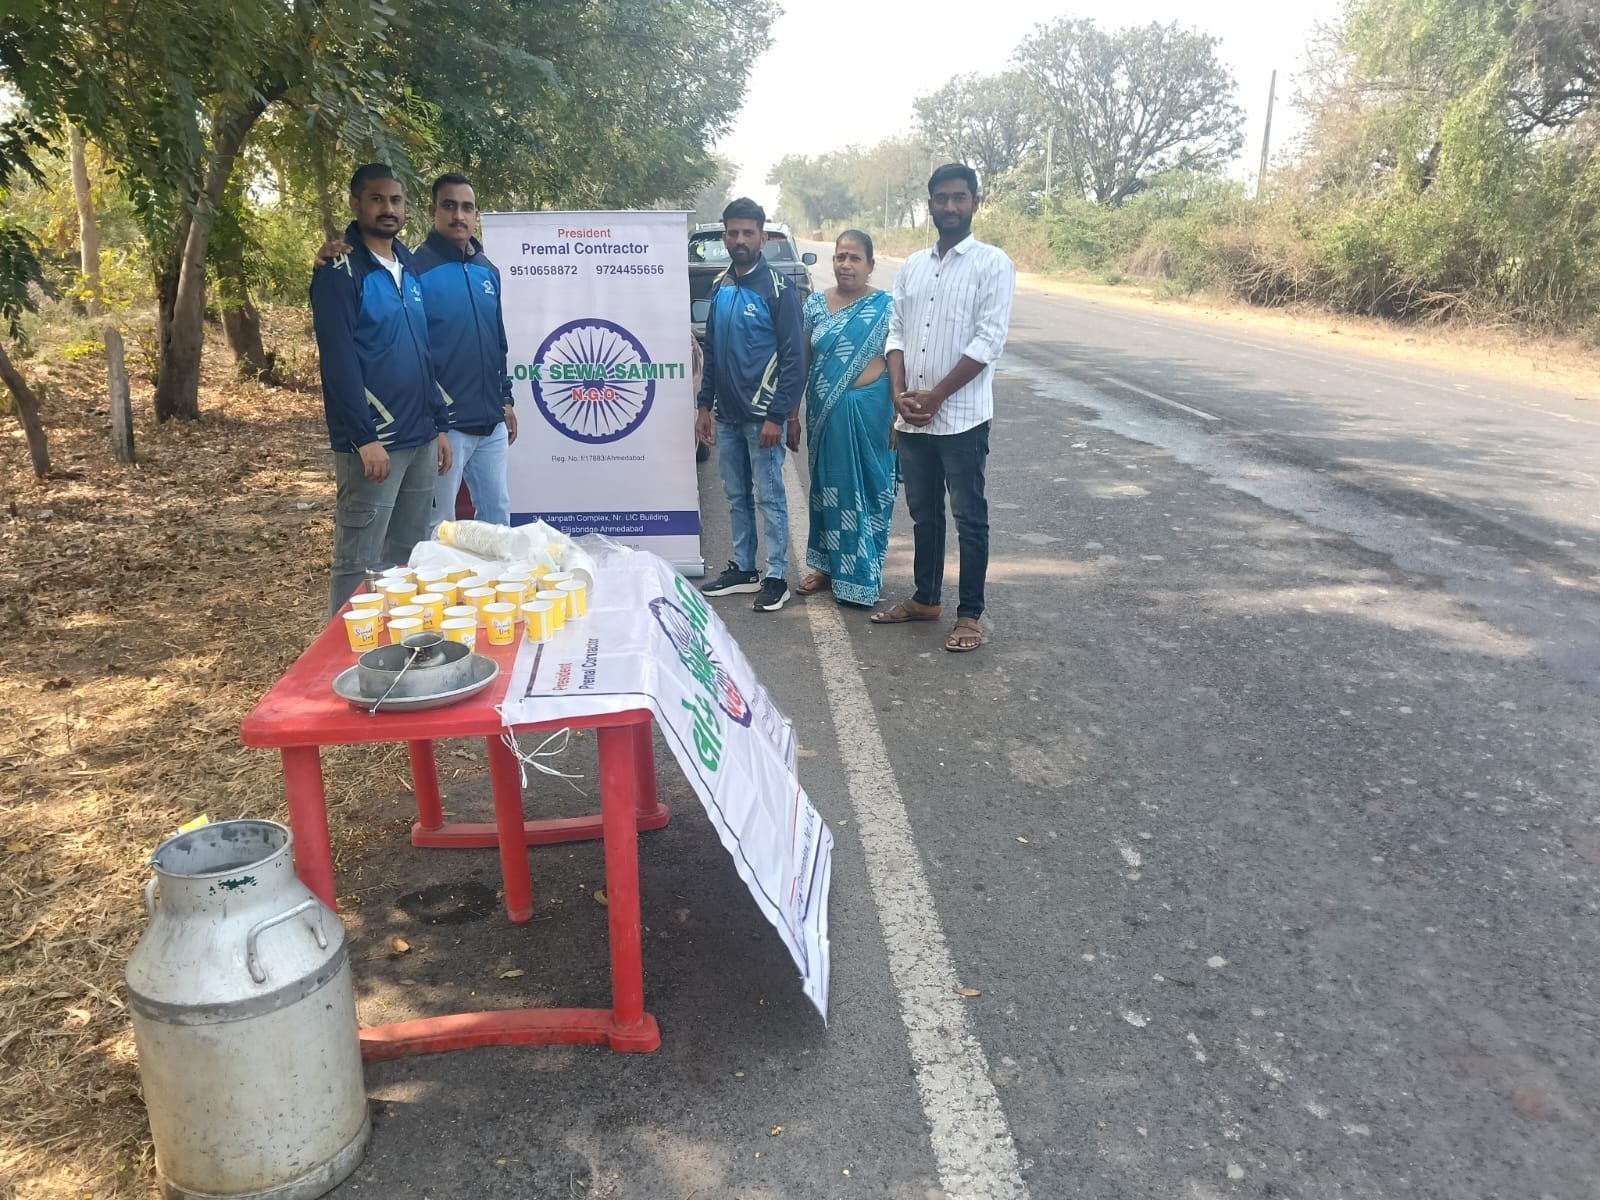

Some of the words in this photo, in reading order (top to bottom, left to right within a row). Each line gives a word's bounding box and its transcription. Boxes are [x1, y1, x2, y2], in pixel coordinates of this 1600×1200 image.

[558, 228, 611, 238] President
[522, 243, 569, 255] Premal
[574, 242, 649, 254] Contractor
[510, 265, 578, 276] 9510658872
[596, 264, 664, 275] 9724455656
[549, 363, 608, 380] SEWA
[614, 363, 685, 379] SAMITI
[572, 387, 619, 401] N.G.O.
[600, 524, 644, 533] Ahmedabad
[578, 669, 596, 689] Premal
